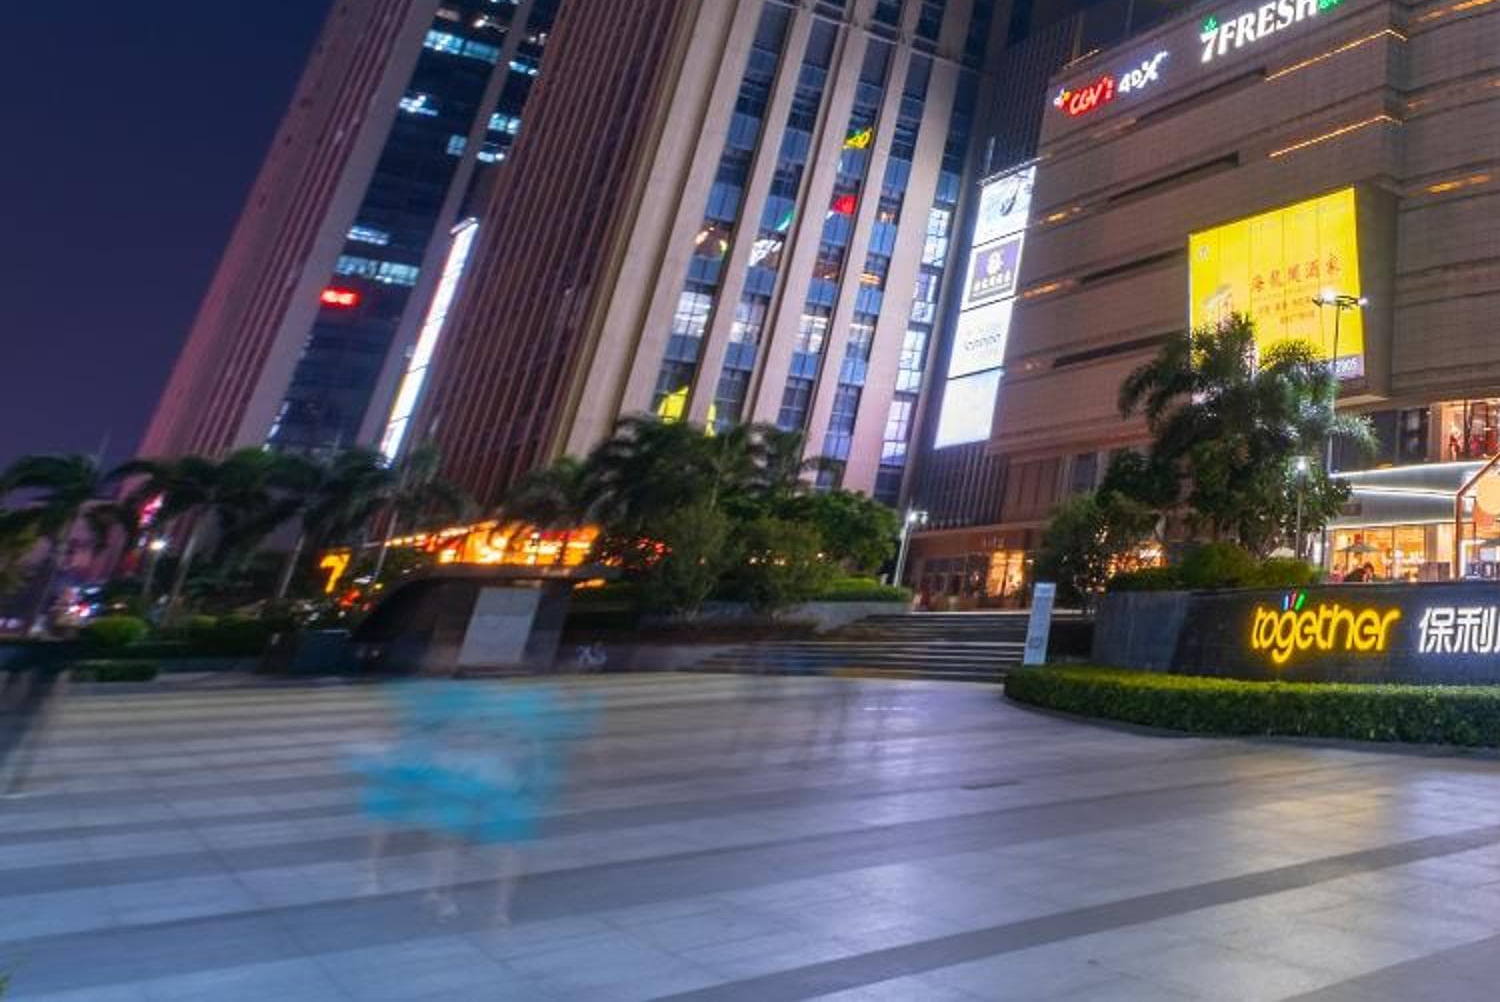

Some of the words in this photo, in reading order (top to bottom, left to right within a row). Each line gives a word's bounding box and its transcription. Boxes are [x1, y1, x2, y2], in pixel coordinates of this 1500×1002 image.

[1068, 83, 1104, 115] CGV
[1118, 51, 1168, 93] 4DX
[1252, 604, 1401, 663] together
